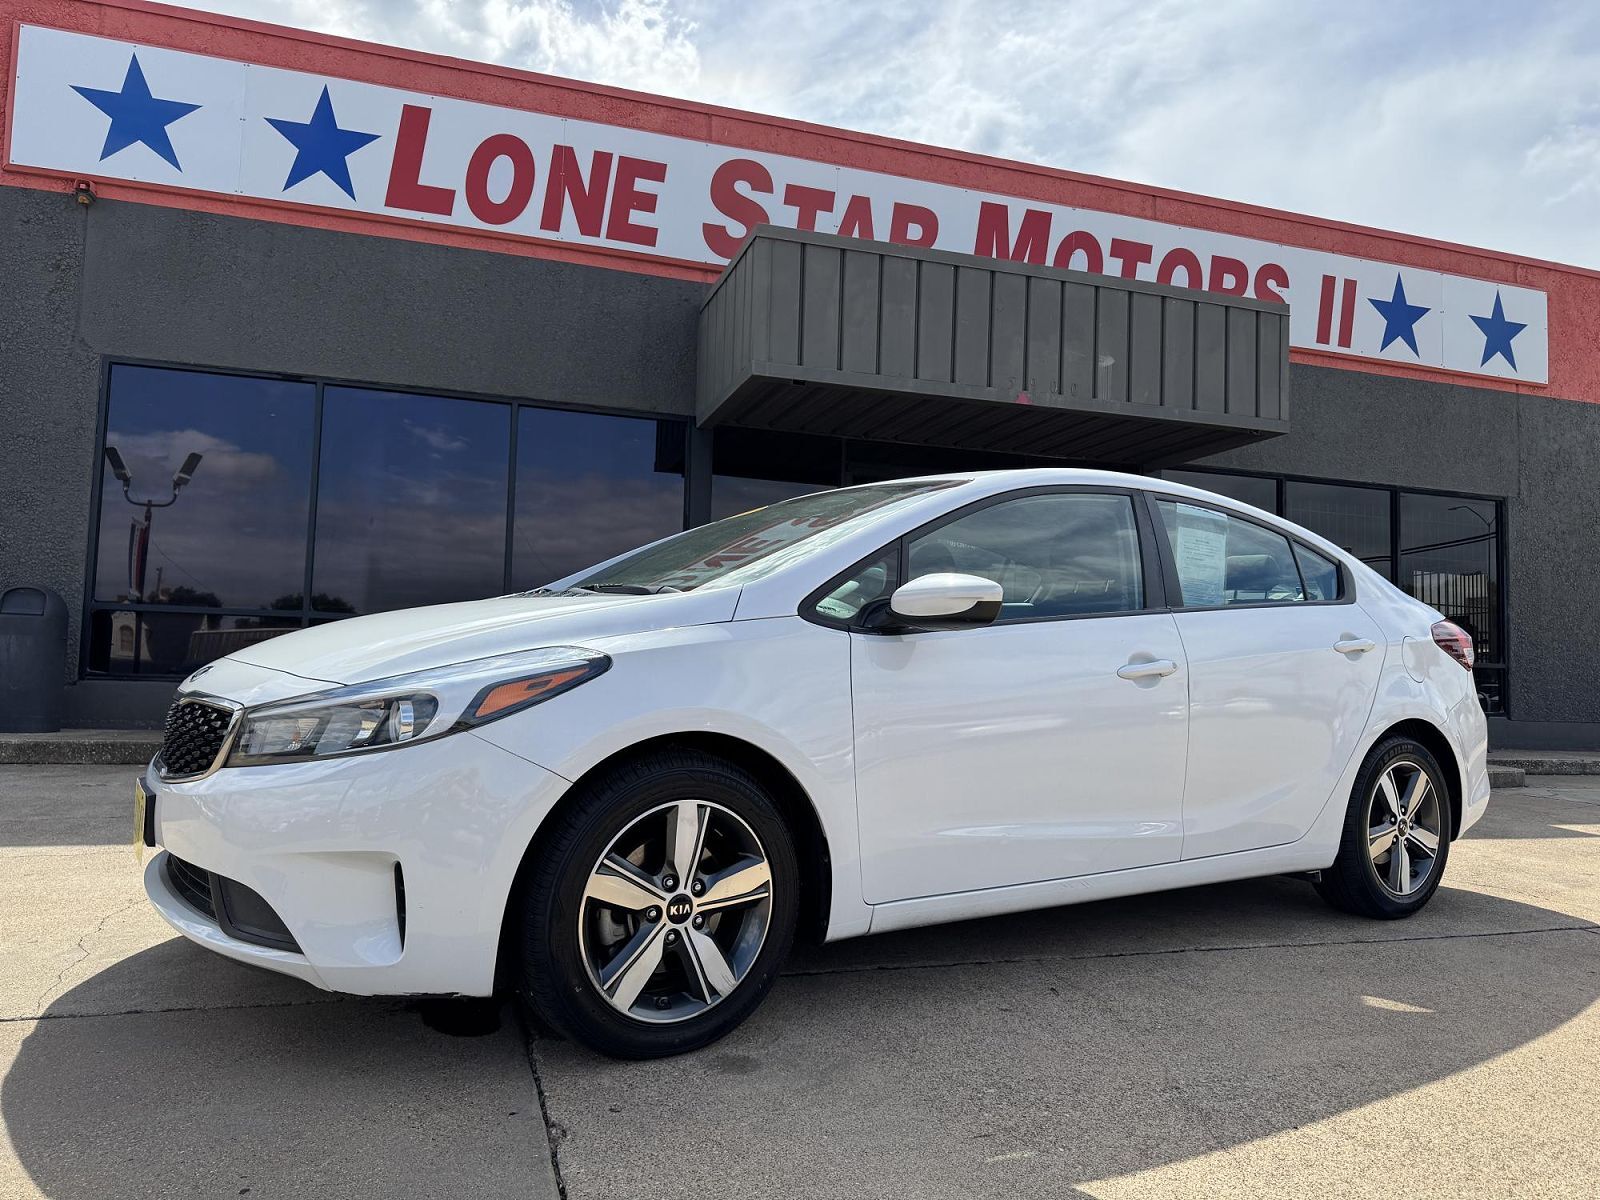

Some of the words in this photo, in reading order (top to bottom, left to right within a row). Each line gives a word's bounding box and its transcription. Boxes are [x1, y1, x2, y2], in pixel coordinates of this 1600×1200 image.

[384, 103, 668, 249] LONE
[1316, 274, 1357, 348] II
[669, 904, 691, 916] KIA
